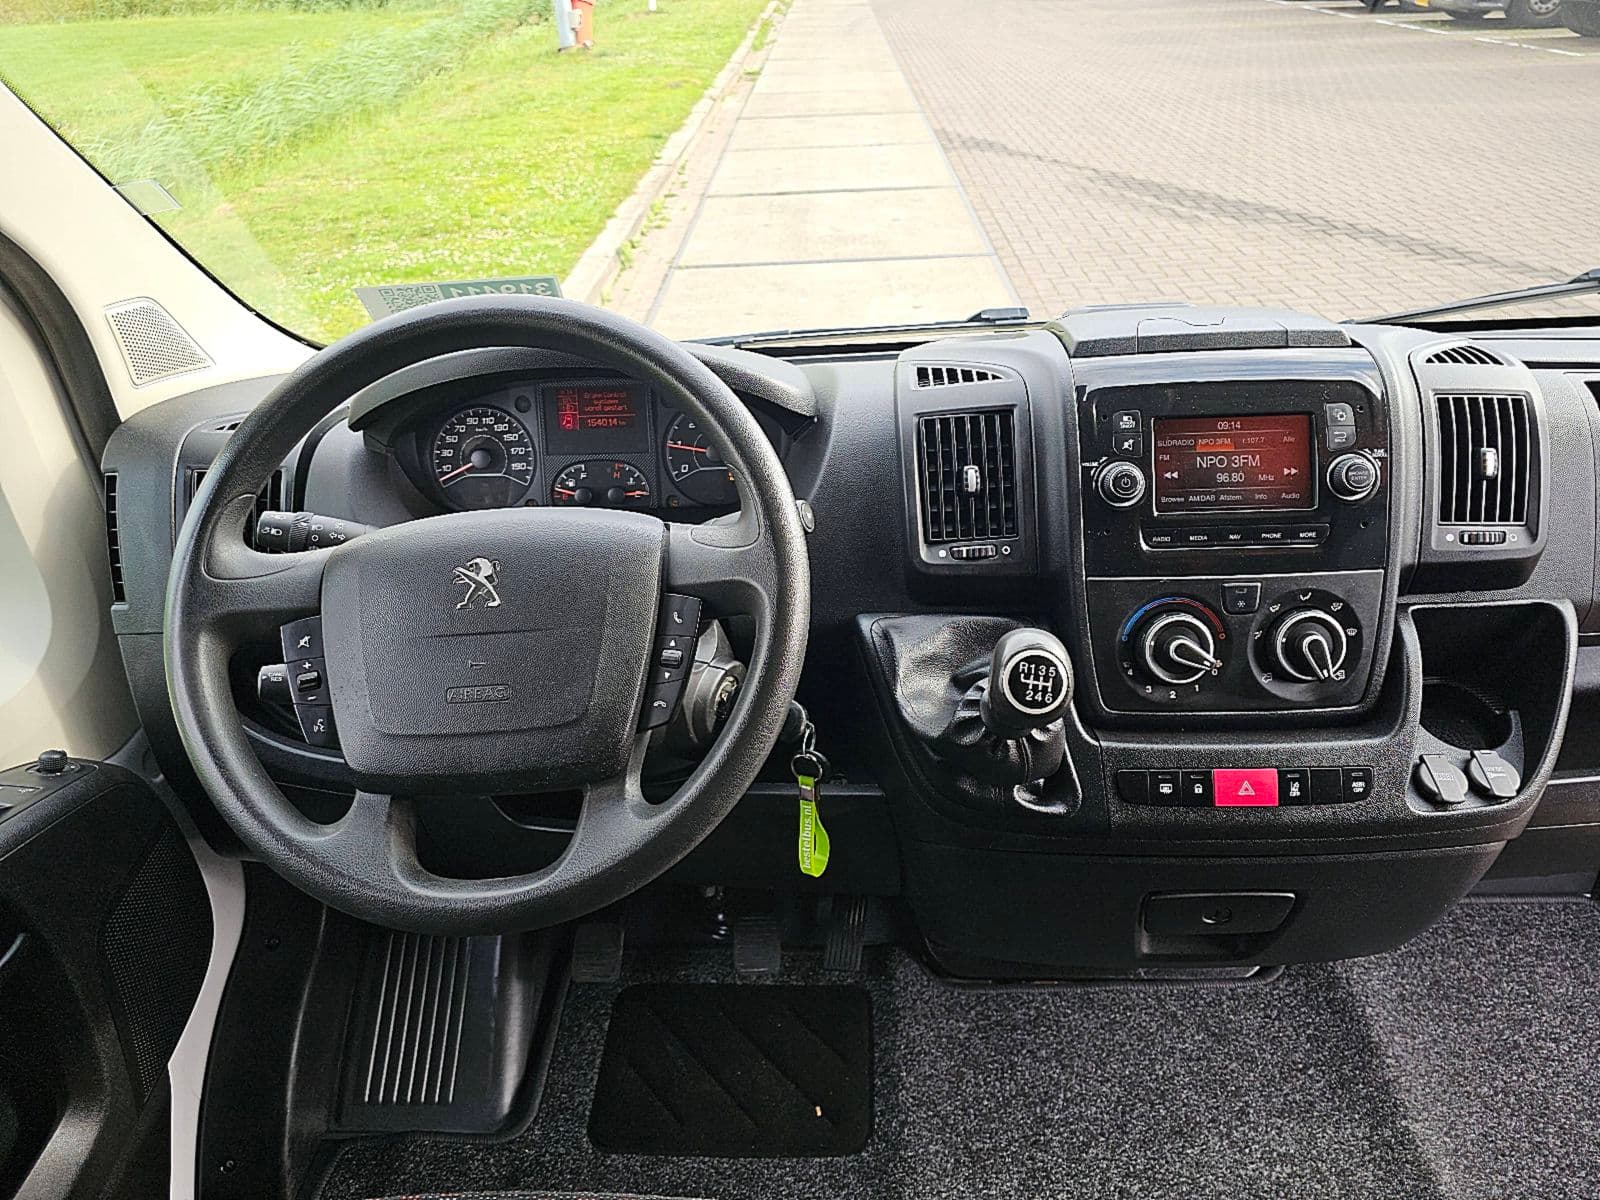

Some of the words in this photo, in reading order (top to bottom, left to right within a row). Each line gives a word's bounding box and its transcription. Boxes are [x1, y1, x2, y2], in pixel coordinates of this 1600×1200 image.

[588, 418, 618, 426] 154014
[1217, 421, 1241, 430] 09:14
[1196, 456, 1227, 468] NPO
[1232, 454, 1260, 468] 3FM
[1216, 472, 1244, 482] 96.80
[1020, 662, 1028, 673] R
[1030, 664, 1036, 674] 1
[1039, 665, 1046, 675] 3
[1048, 667, 1056, 677] 5
[1025, 690, 1033, 700] 2
[1034, 692, 1042, 702] 4
[1045, 693, 1053, 704] 6
[802, 806, 812, 869] bestelbus.nl
